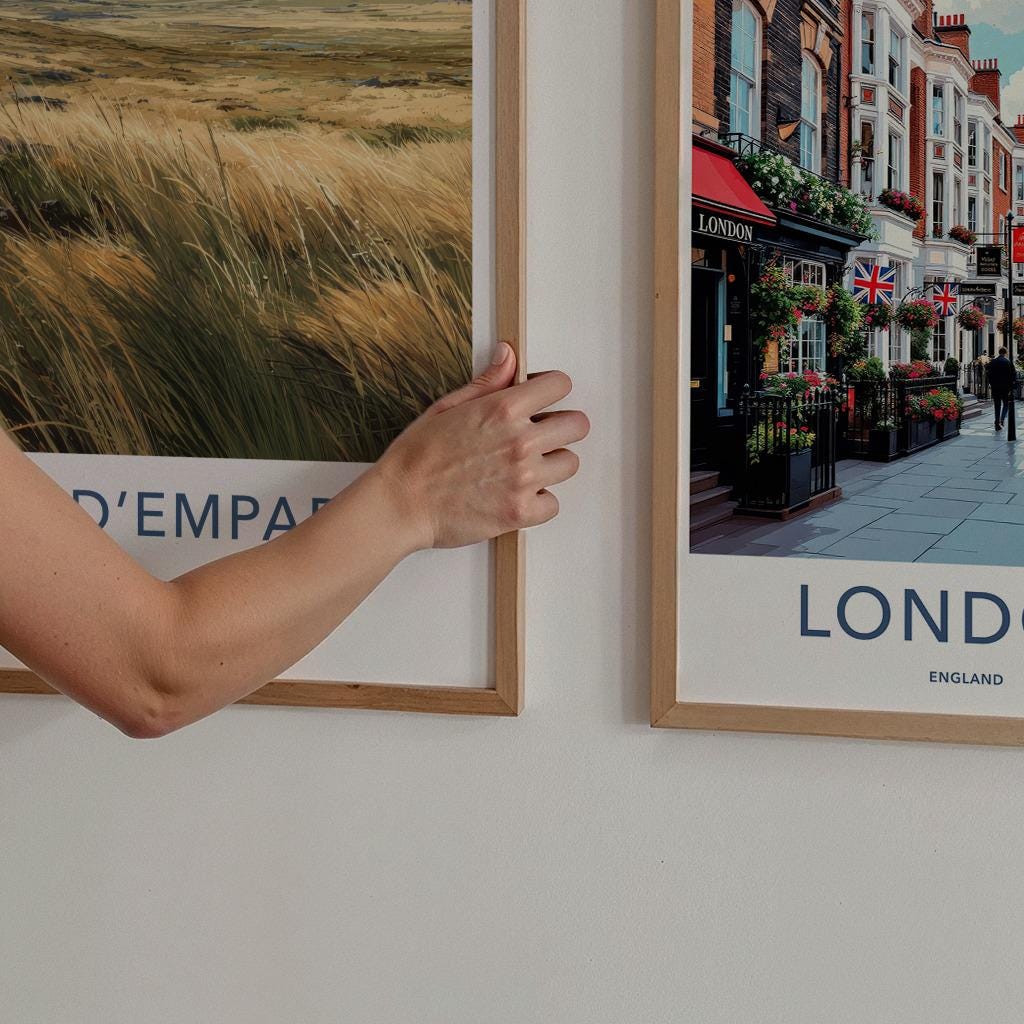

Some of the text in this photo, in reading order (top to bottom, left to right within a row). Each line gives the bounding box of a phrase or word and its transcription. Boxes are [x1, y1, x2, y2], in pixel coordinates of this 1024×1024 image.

[698, 213, 753, 242] LONDON
[801, 584, 1024, 645] LOND
[929, 670, 1004, 686] ENGLAND
